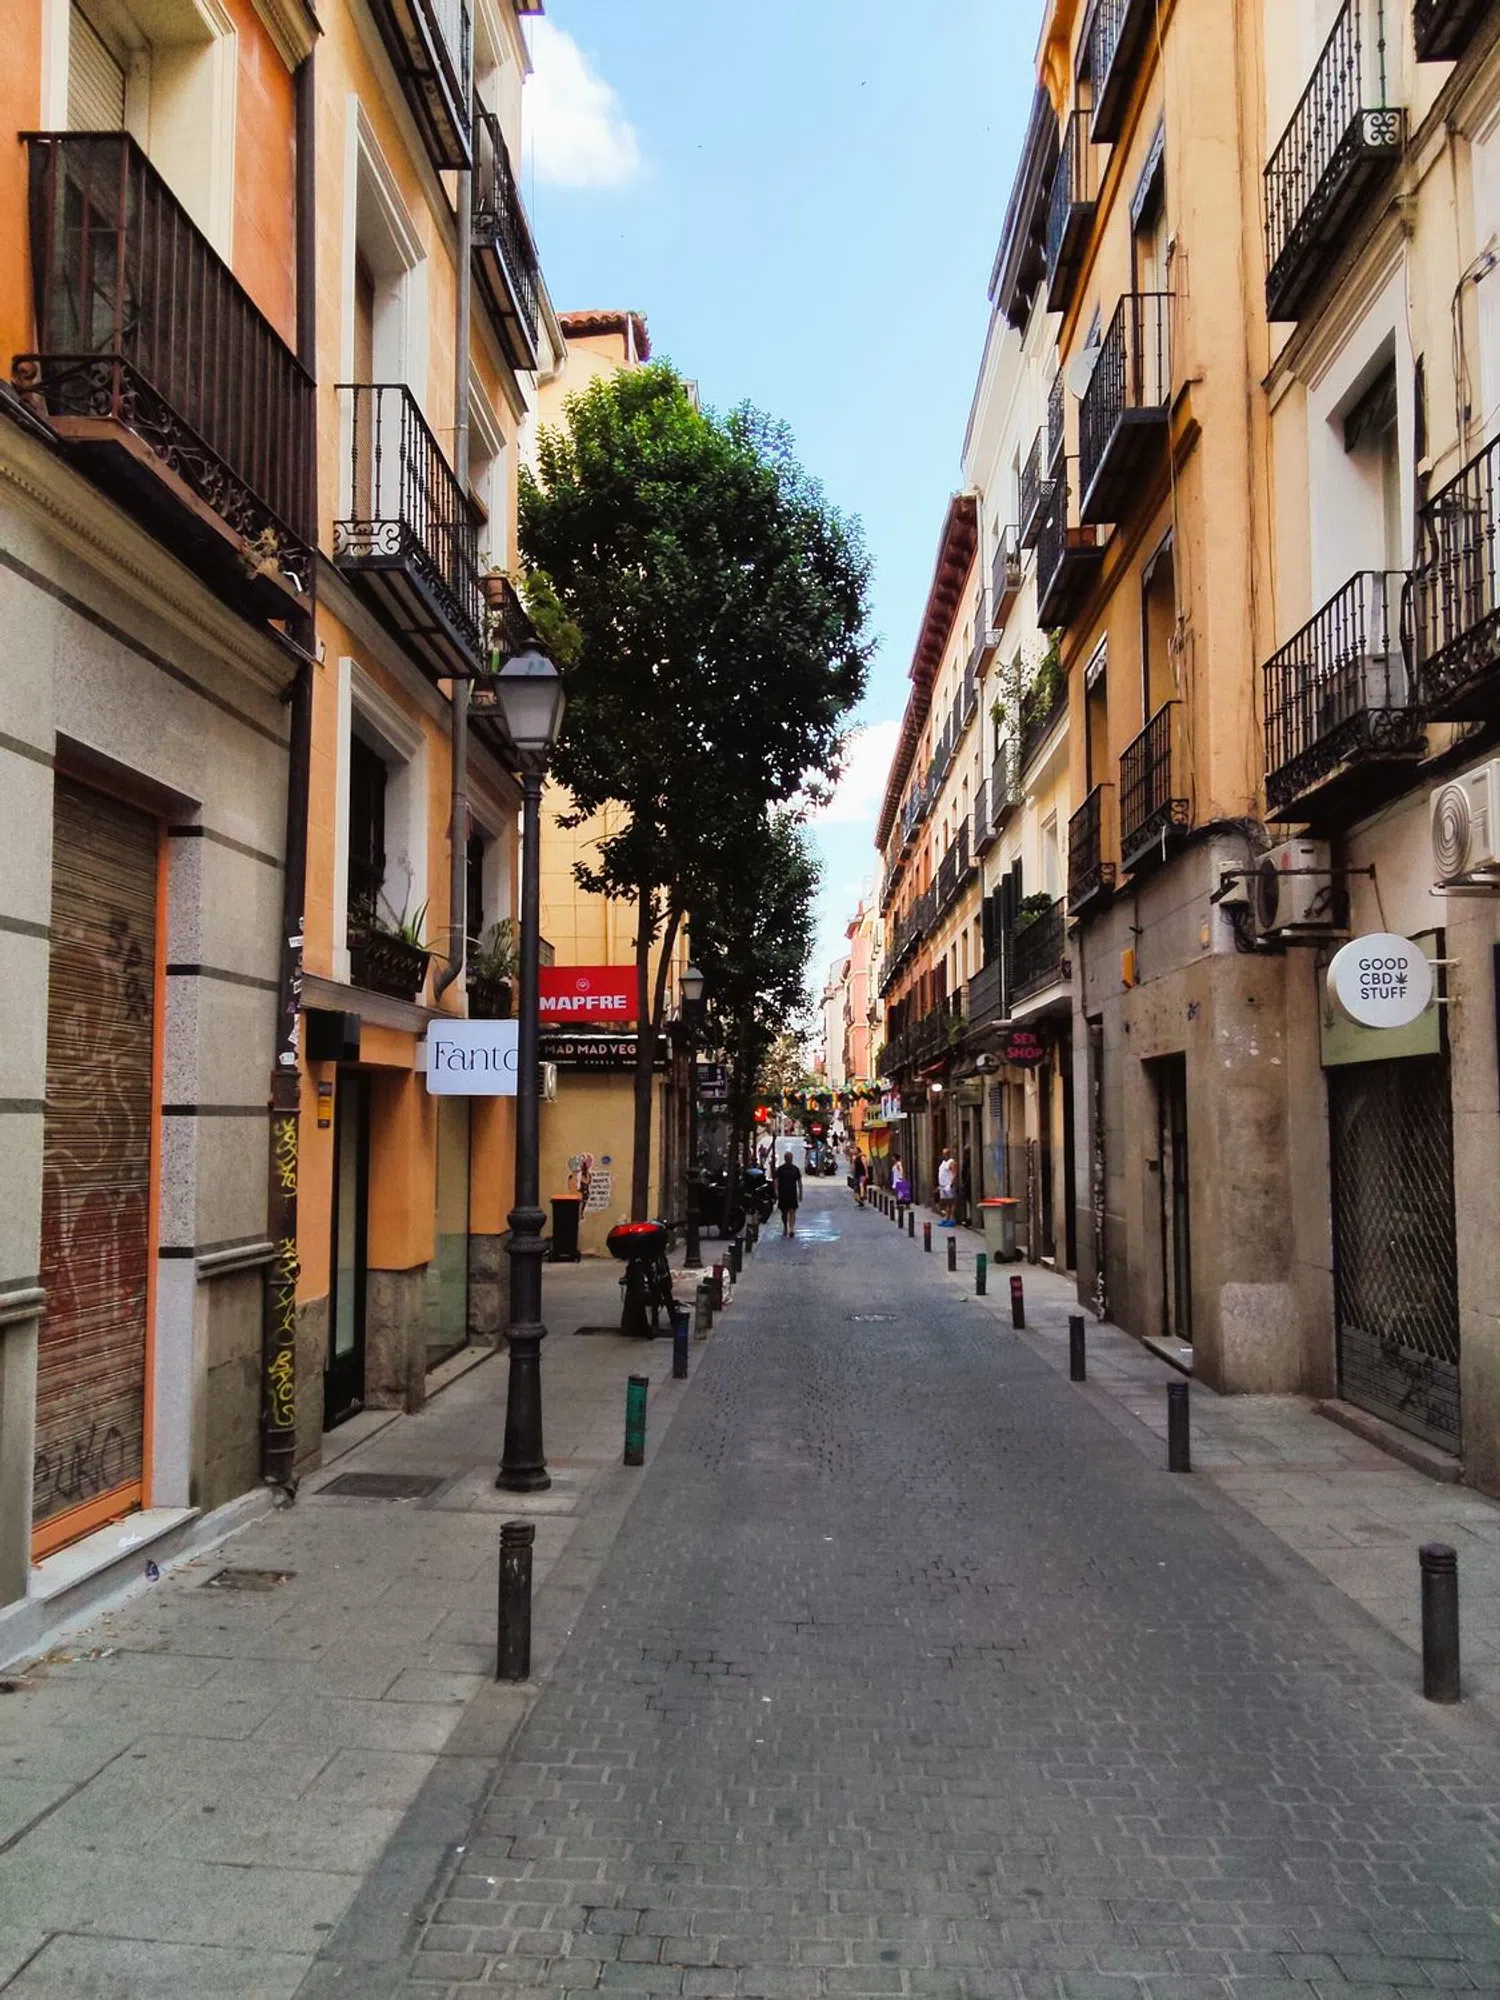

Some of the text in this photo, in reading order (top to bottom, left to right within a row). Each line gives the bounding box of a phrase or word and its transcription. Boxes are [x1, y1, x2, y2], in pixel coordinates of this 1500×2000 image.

[1359, 957, 1408, 971] GOOD
[1360, 972, 1393, 985] CBD
[1361, 986, 1407, 1000] STUFF
[539, 994, 627, 1011] MAPFRE
[1012, 1032, 1037, 1045] SEX
[545, 1044, 637, 1055] MAD MAD VEG
[1006, 1046, 1043, 1059] SHOP
